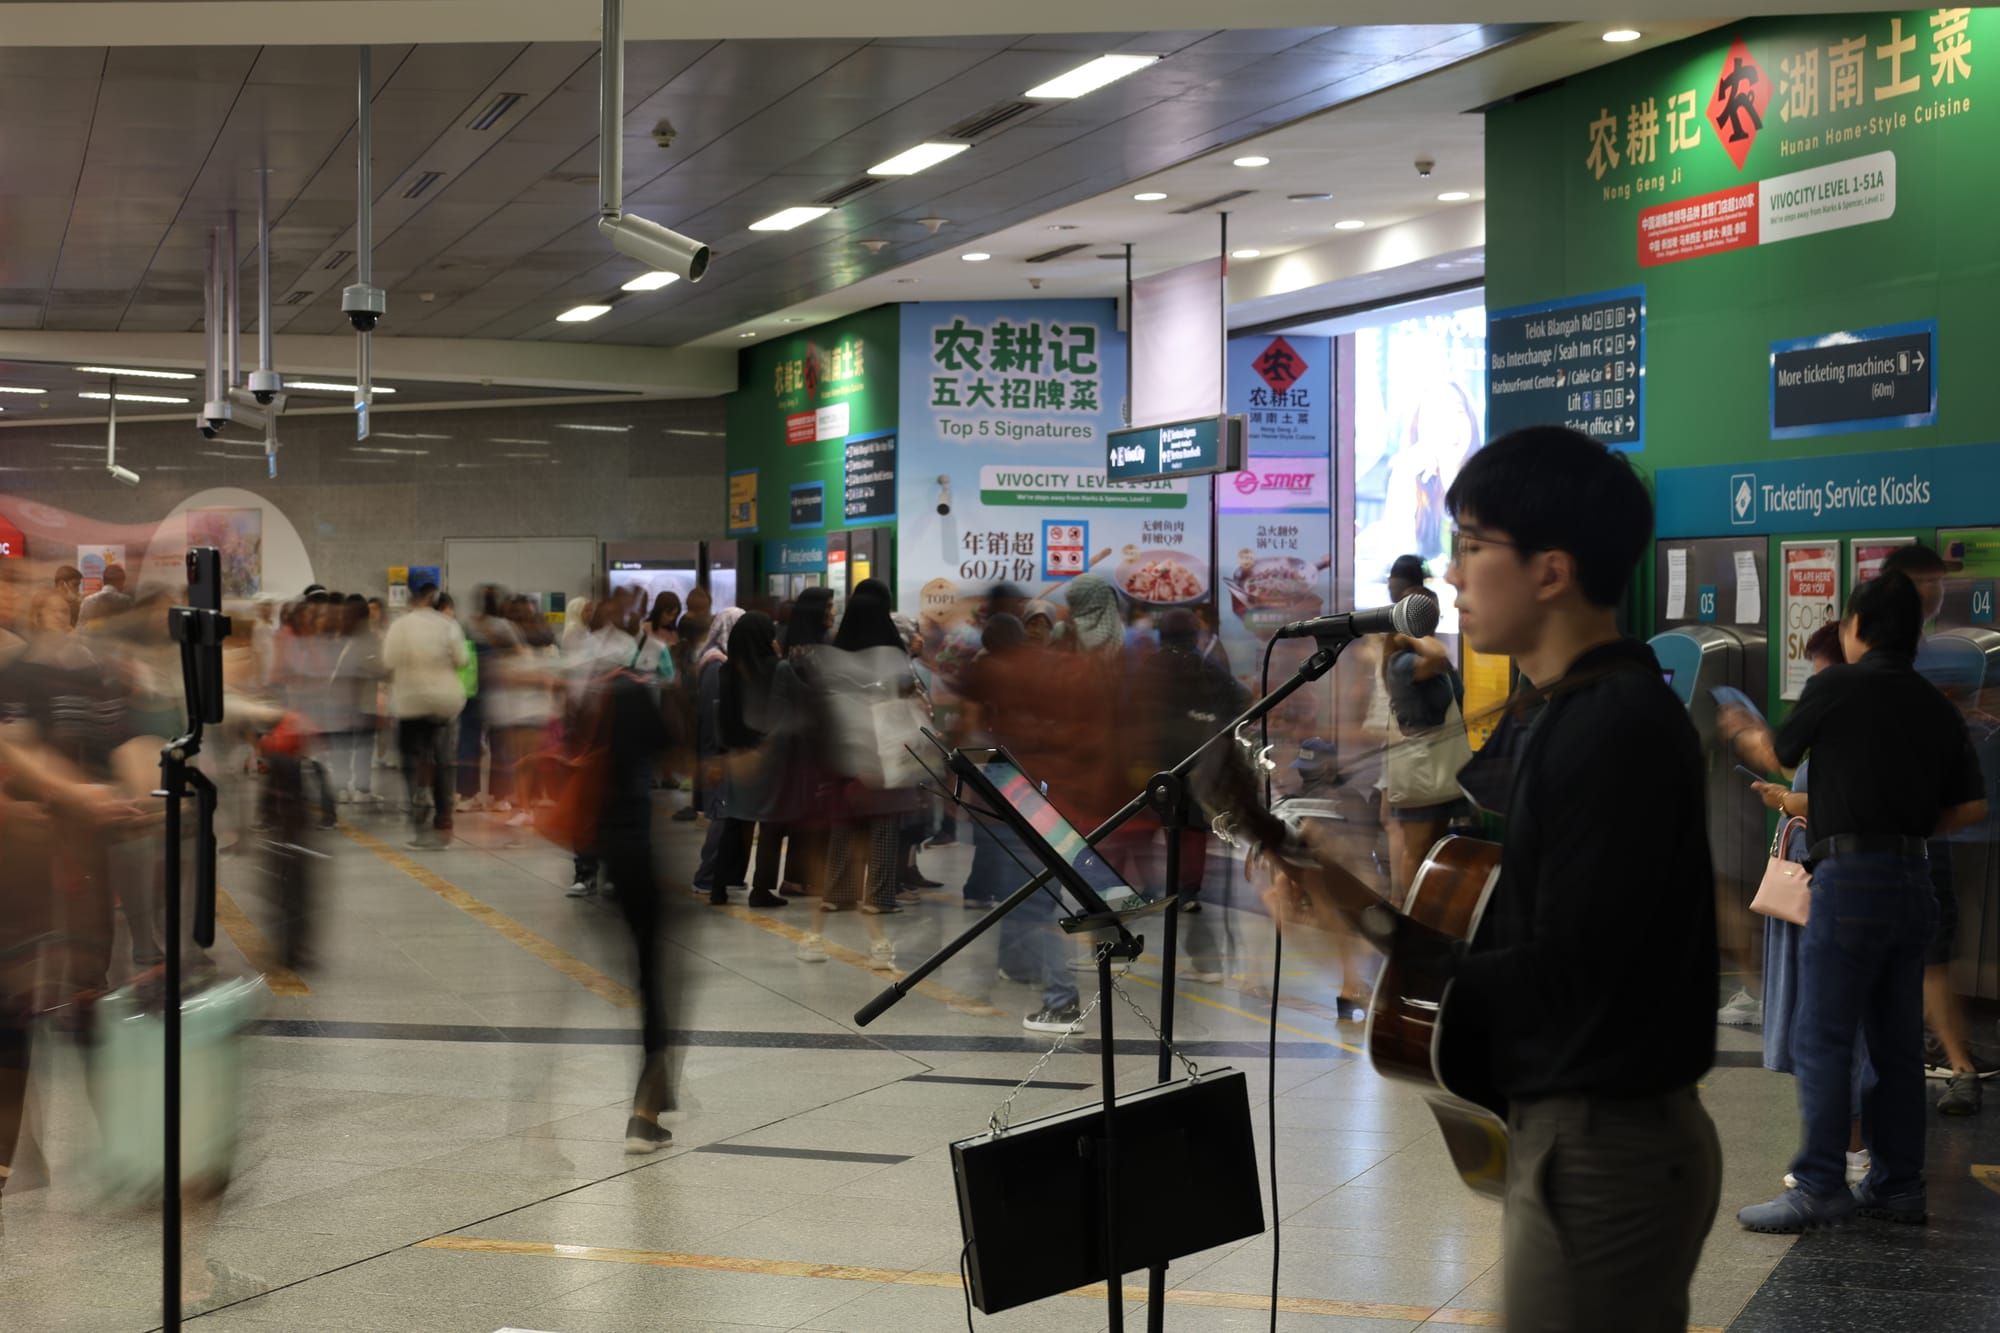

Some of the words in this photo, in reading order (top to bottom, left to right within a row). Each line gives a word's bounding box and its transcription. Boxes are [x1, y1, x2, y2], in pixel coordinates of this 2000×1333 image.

[1780, 8, 1972, 123] 湖南土菜
[1586, 89, 1701, 181] 农耕记
[1780, 136, 1819, 157] Hunan
[1826, 112, 1907, 145] Home-Style
[1914, 97, 1970, 124] Cuisine
[1603, 184, 1630, 200] Nong
[1636, 175, 1665, 192] Geng
[1671, 166, 1682, 184] Ji
[1770, 185, 1816, 211] VIVOCITY
[1818, 178, 1850, 201] LEVEL
[1853, 169, 1884, 193] 1-51A
[1524, 321, 1546, 339] Telok
[1548, 314, 1580, 338] Blangah
[1582, 312, 1593, 331] Rd
[934, 319, 1097, 374] 农耕记
[1492, 353, 1505, 369] Bus
[1506, 347, 1552, 367] Interchange
[1559, 342, 1578, 360] Seah
[1580, 341, 1591, 358] Im
[1593, 338, 1603, 356] FC
[1535, 374, 1555, 390] Centre
[1572, 370, 1590, 385] Cable
[1591, 368, 1602, 383] Car
[1778, 370, 1802, 387] More
[1804, 362, 1845, 384] ticketing
[1847, 355, 1895, 378] machines
[931, 377, 1098, 410] 五大招牌菜
[1249, 387, 1310, 408] 农耕记
[1568, 393, 1581, 411] Lift
[1872, 381, 1895, 400] (60m)
[940, 419, 973, 437] Top
[979, 420, 989, 434] 5
[994, 420, 1092, 439] Signatures
[1250, 412, 1309, 424] 湖南土菜
[1590, 416, 1613, 436] office
[996, 473, 1069, 488] VIVOCITY
[1260, 473, 1315, 489] SMRT
[1762, 483, 1822, 517] Ticketing
[1825, 479, 1877, 509] Service
[1881, 474, 1931, 506] Kiosks
[963, 531, 1035, 556] 年销超
[960, 559, 1036, 582] 60万份
[1799, 583, 1812, 593] FOR
[1812, 583, 1825, 593] YOU
[1701, 593, 1714, 614] 03
[1973, 591, 1990, 615] 04
